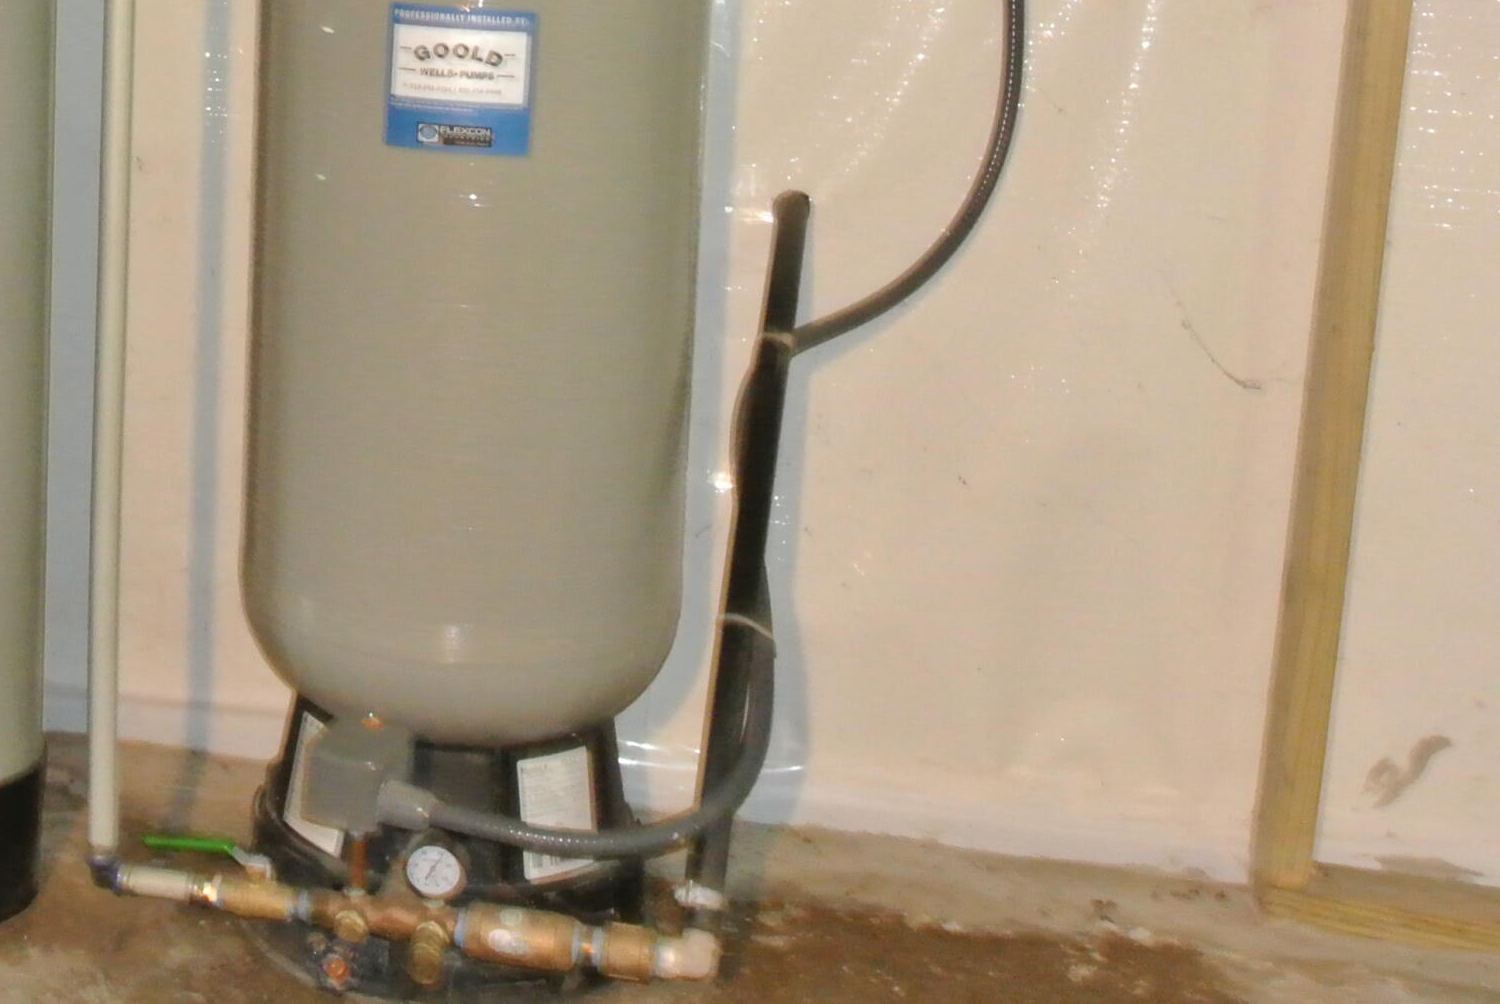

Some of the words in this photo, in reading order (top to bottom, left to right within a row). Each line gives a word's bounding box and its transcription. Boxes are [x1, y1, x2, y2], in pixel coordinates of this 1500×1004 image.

[394, 8, 465, 22] PROFESSIONALLY
[467, 14, 514, 25] INSTALLED
[413, 42, 504, 67] GOOLD
[460, 70, 495, 81] PUMPS
[439, 125, 491, 136] FLEXCON
